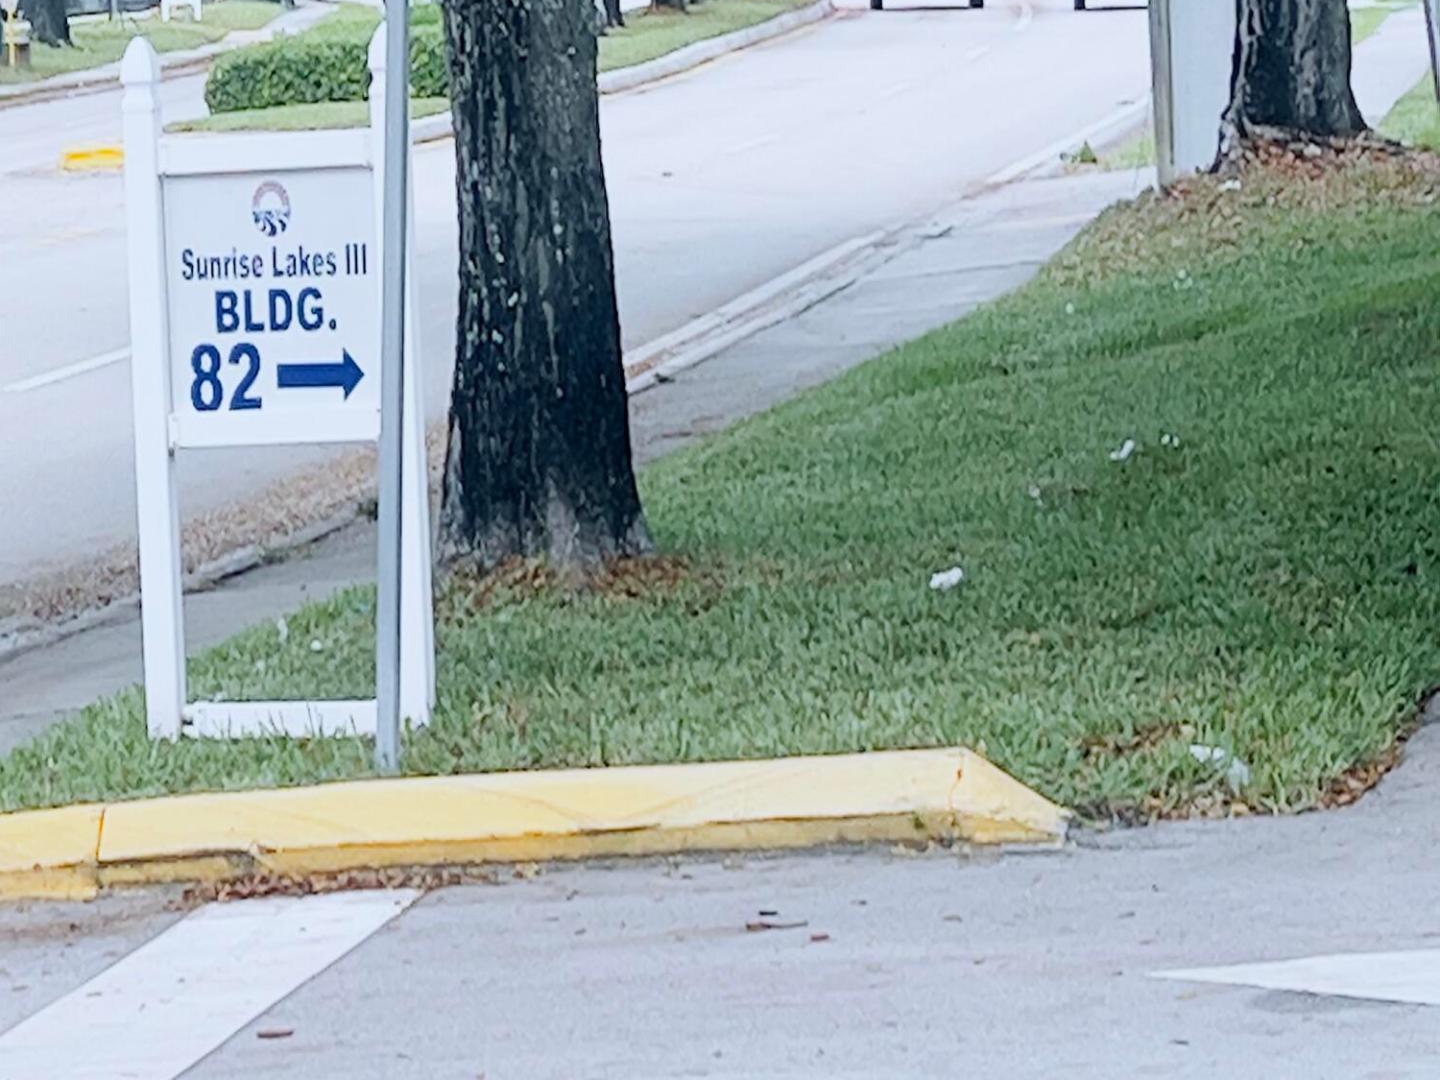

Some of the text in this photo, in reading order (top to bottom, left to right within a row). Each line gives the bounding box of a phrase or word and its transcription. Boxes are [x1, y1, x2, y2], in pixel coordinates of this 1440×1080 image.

[182, 242, 367, 280] Sunrise Lakes III
[215, 286, 338, 334] BLDG.
[190, 342, 263, 412] 82
